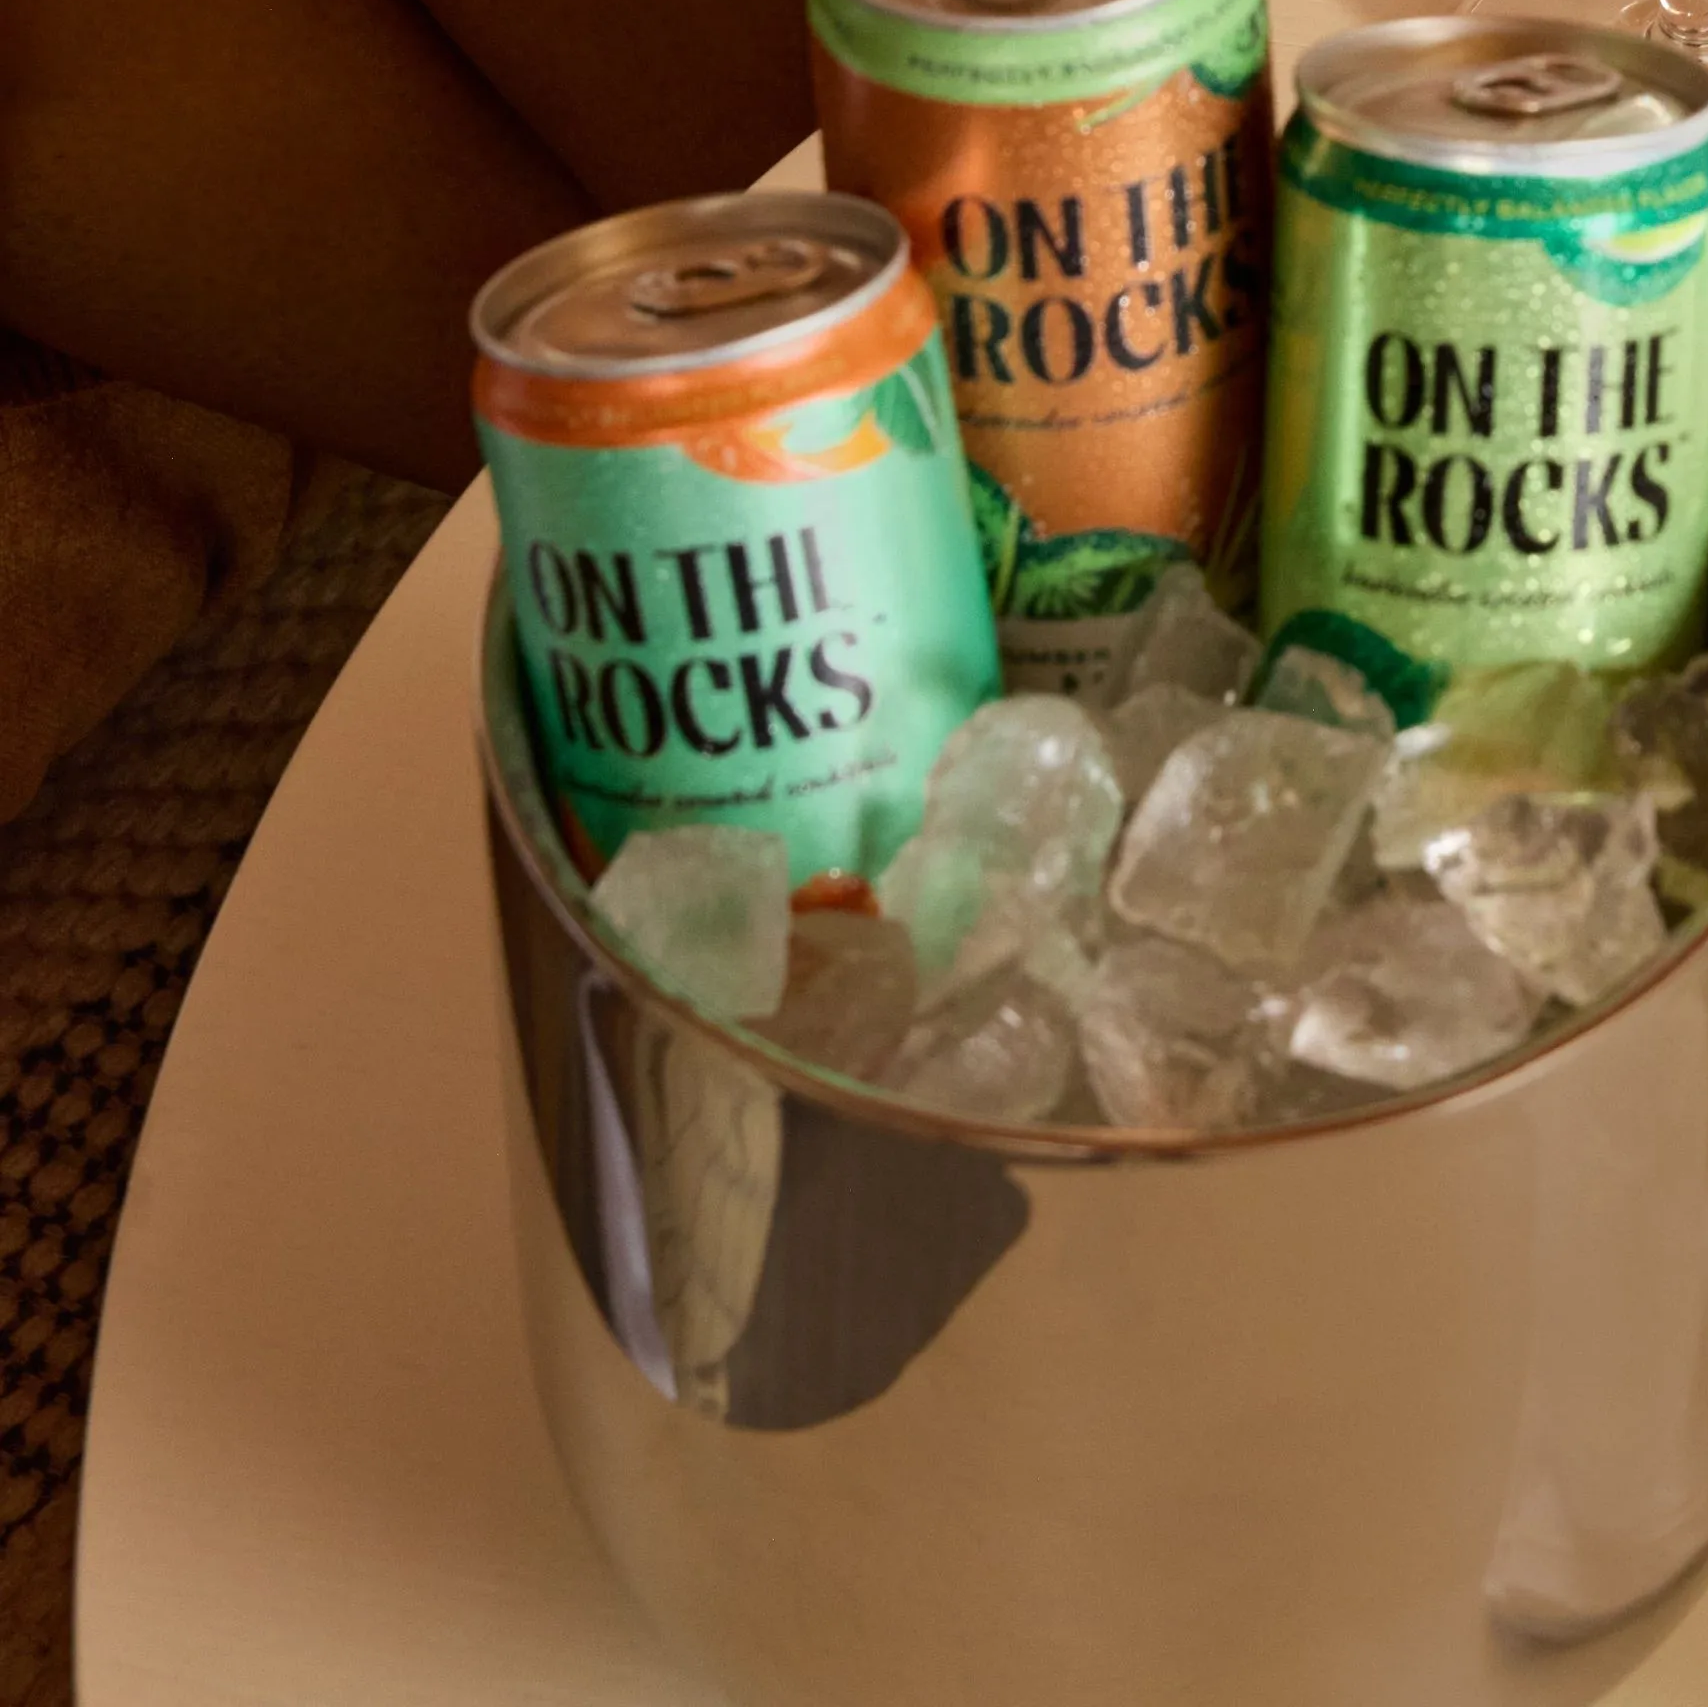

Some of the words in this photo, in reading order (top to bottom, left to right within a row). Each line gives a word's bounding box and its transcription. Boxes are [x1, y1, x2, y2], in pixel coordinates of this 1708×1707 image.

[940, 195, 1085, 280] ON
[1363, 329, 1498, 441] ON
[1526, 326, 1680, 442] THE
[1359, 440, 1674, 558] ROCKS
[528, 539, 647, 644] ON
[549, 631, 874, 760] ROCKS
